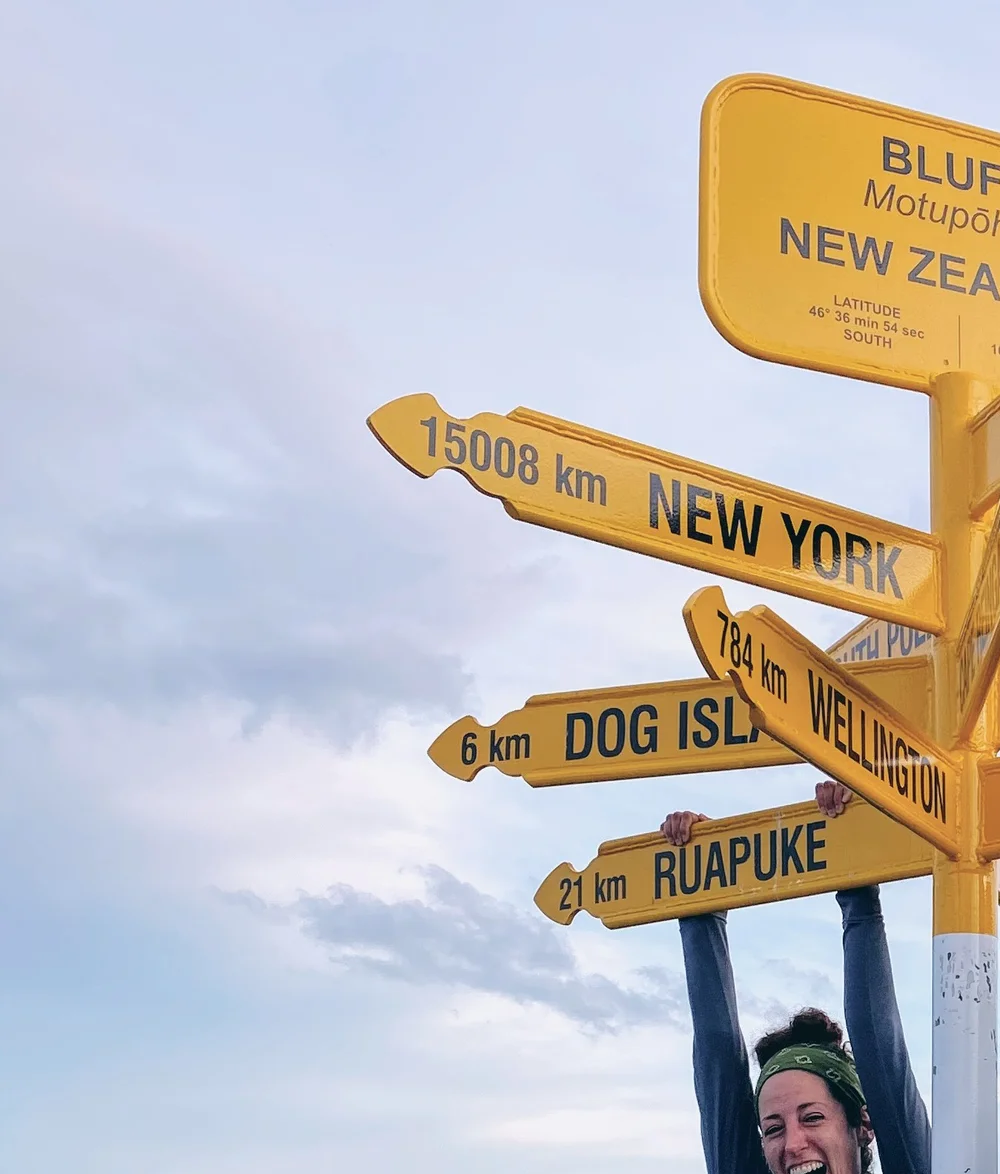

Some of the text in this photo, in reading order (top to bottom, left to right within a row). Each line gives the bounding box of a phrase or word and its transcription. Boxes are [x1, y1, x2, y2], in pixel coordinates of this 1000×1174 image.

[779, 216, 894, 276] NEW
[808, 305, 925, 339] 46° 36 min 54 sec
[833, 294, 901, 319] LATITUDE
[843, 328, 892, 349] SOUTH
[419, 415, 905, 600] 15008 km NEW YORK
[460, 696, 759, 765] 6 km DOG ISL
[716, 608, 947, 825] 784 km WELLINGTON
[558, 820, 828, 912] 21 km RUAPUKE
